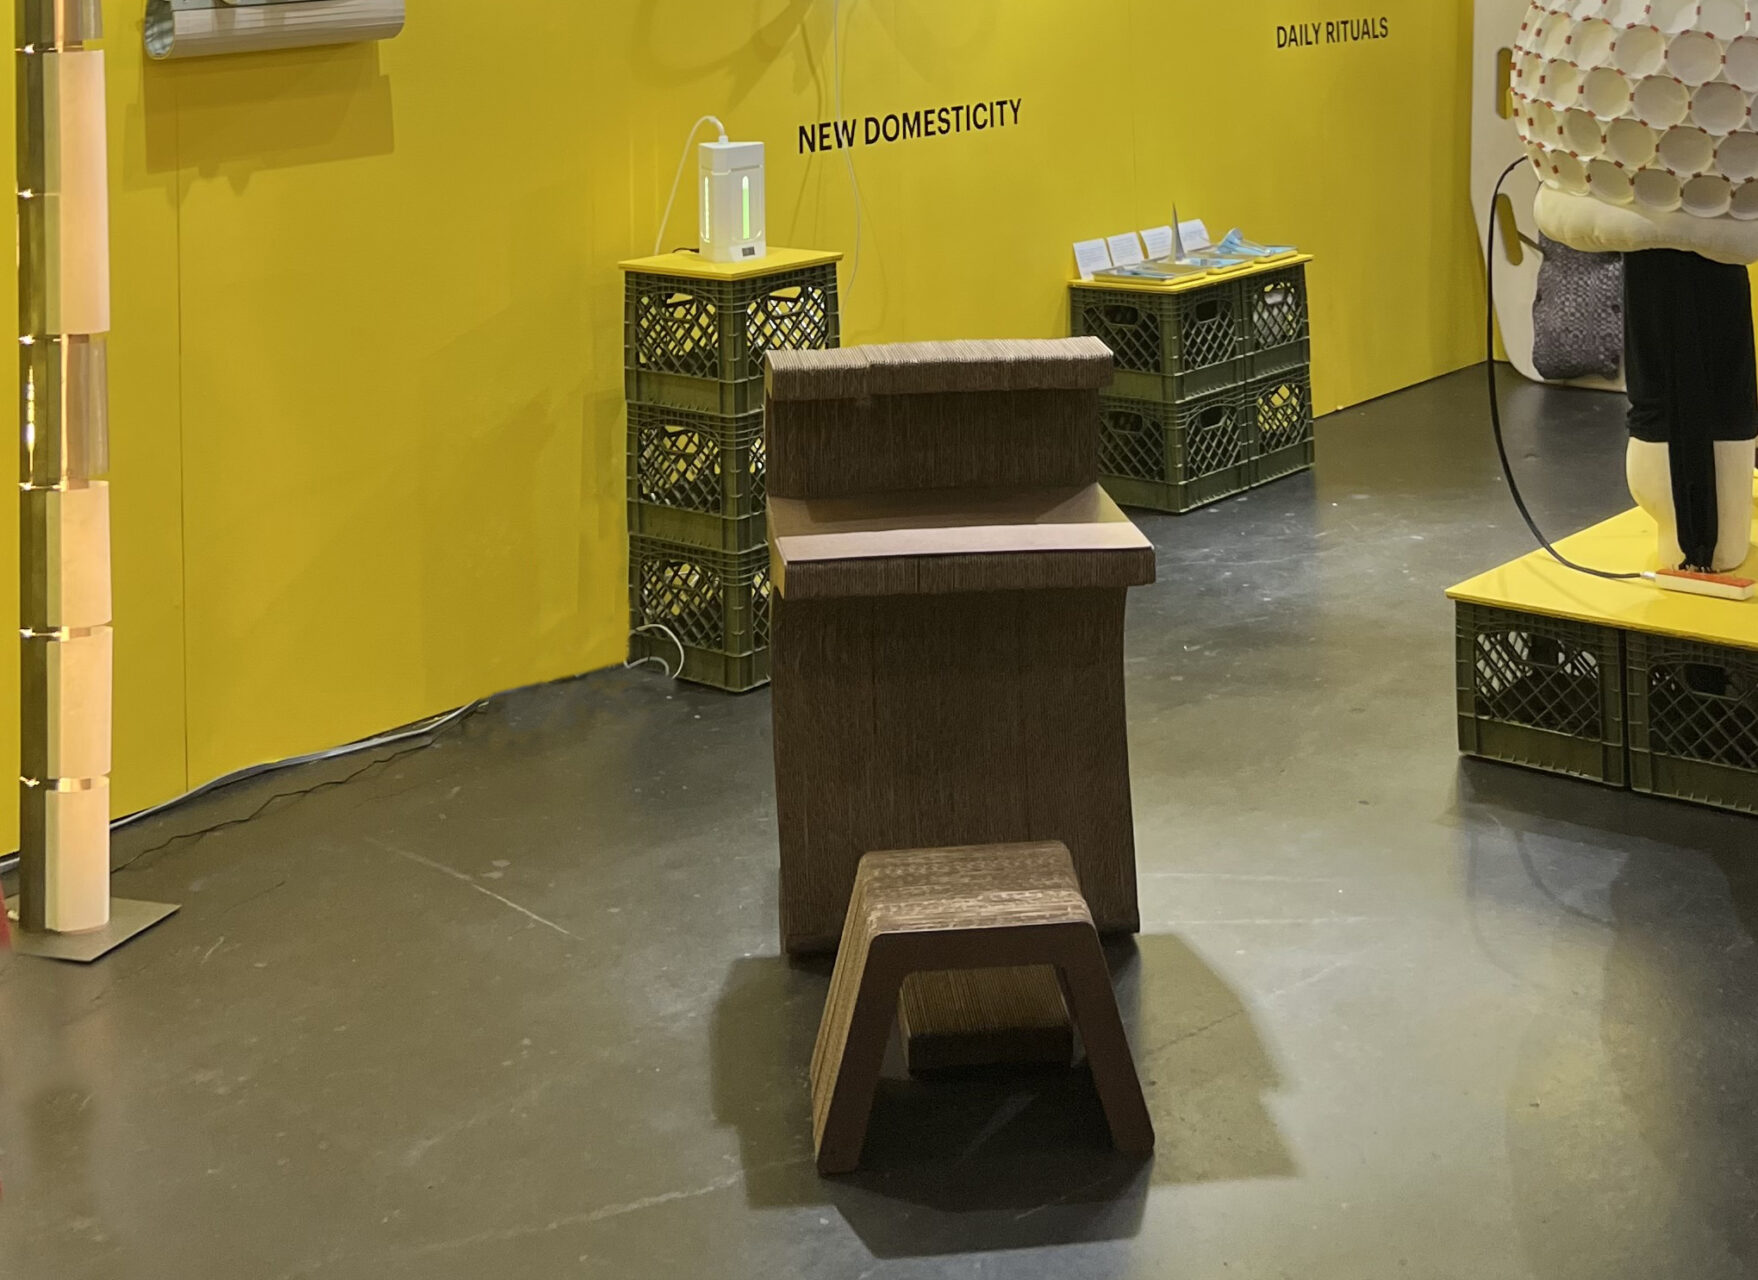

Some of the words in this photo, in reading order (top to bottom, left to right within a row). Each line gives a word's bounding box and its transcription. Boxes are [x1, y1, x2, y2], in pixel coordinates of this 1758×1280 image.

[1275, 23, 1322, 50] DAILY
[1325, 16, 1389, 45] RITUALS
[798, 119, 857, 155] NEW
[864, 98, 1021, 146] DOMESTICITY
